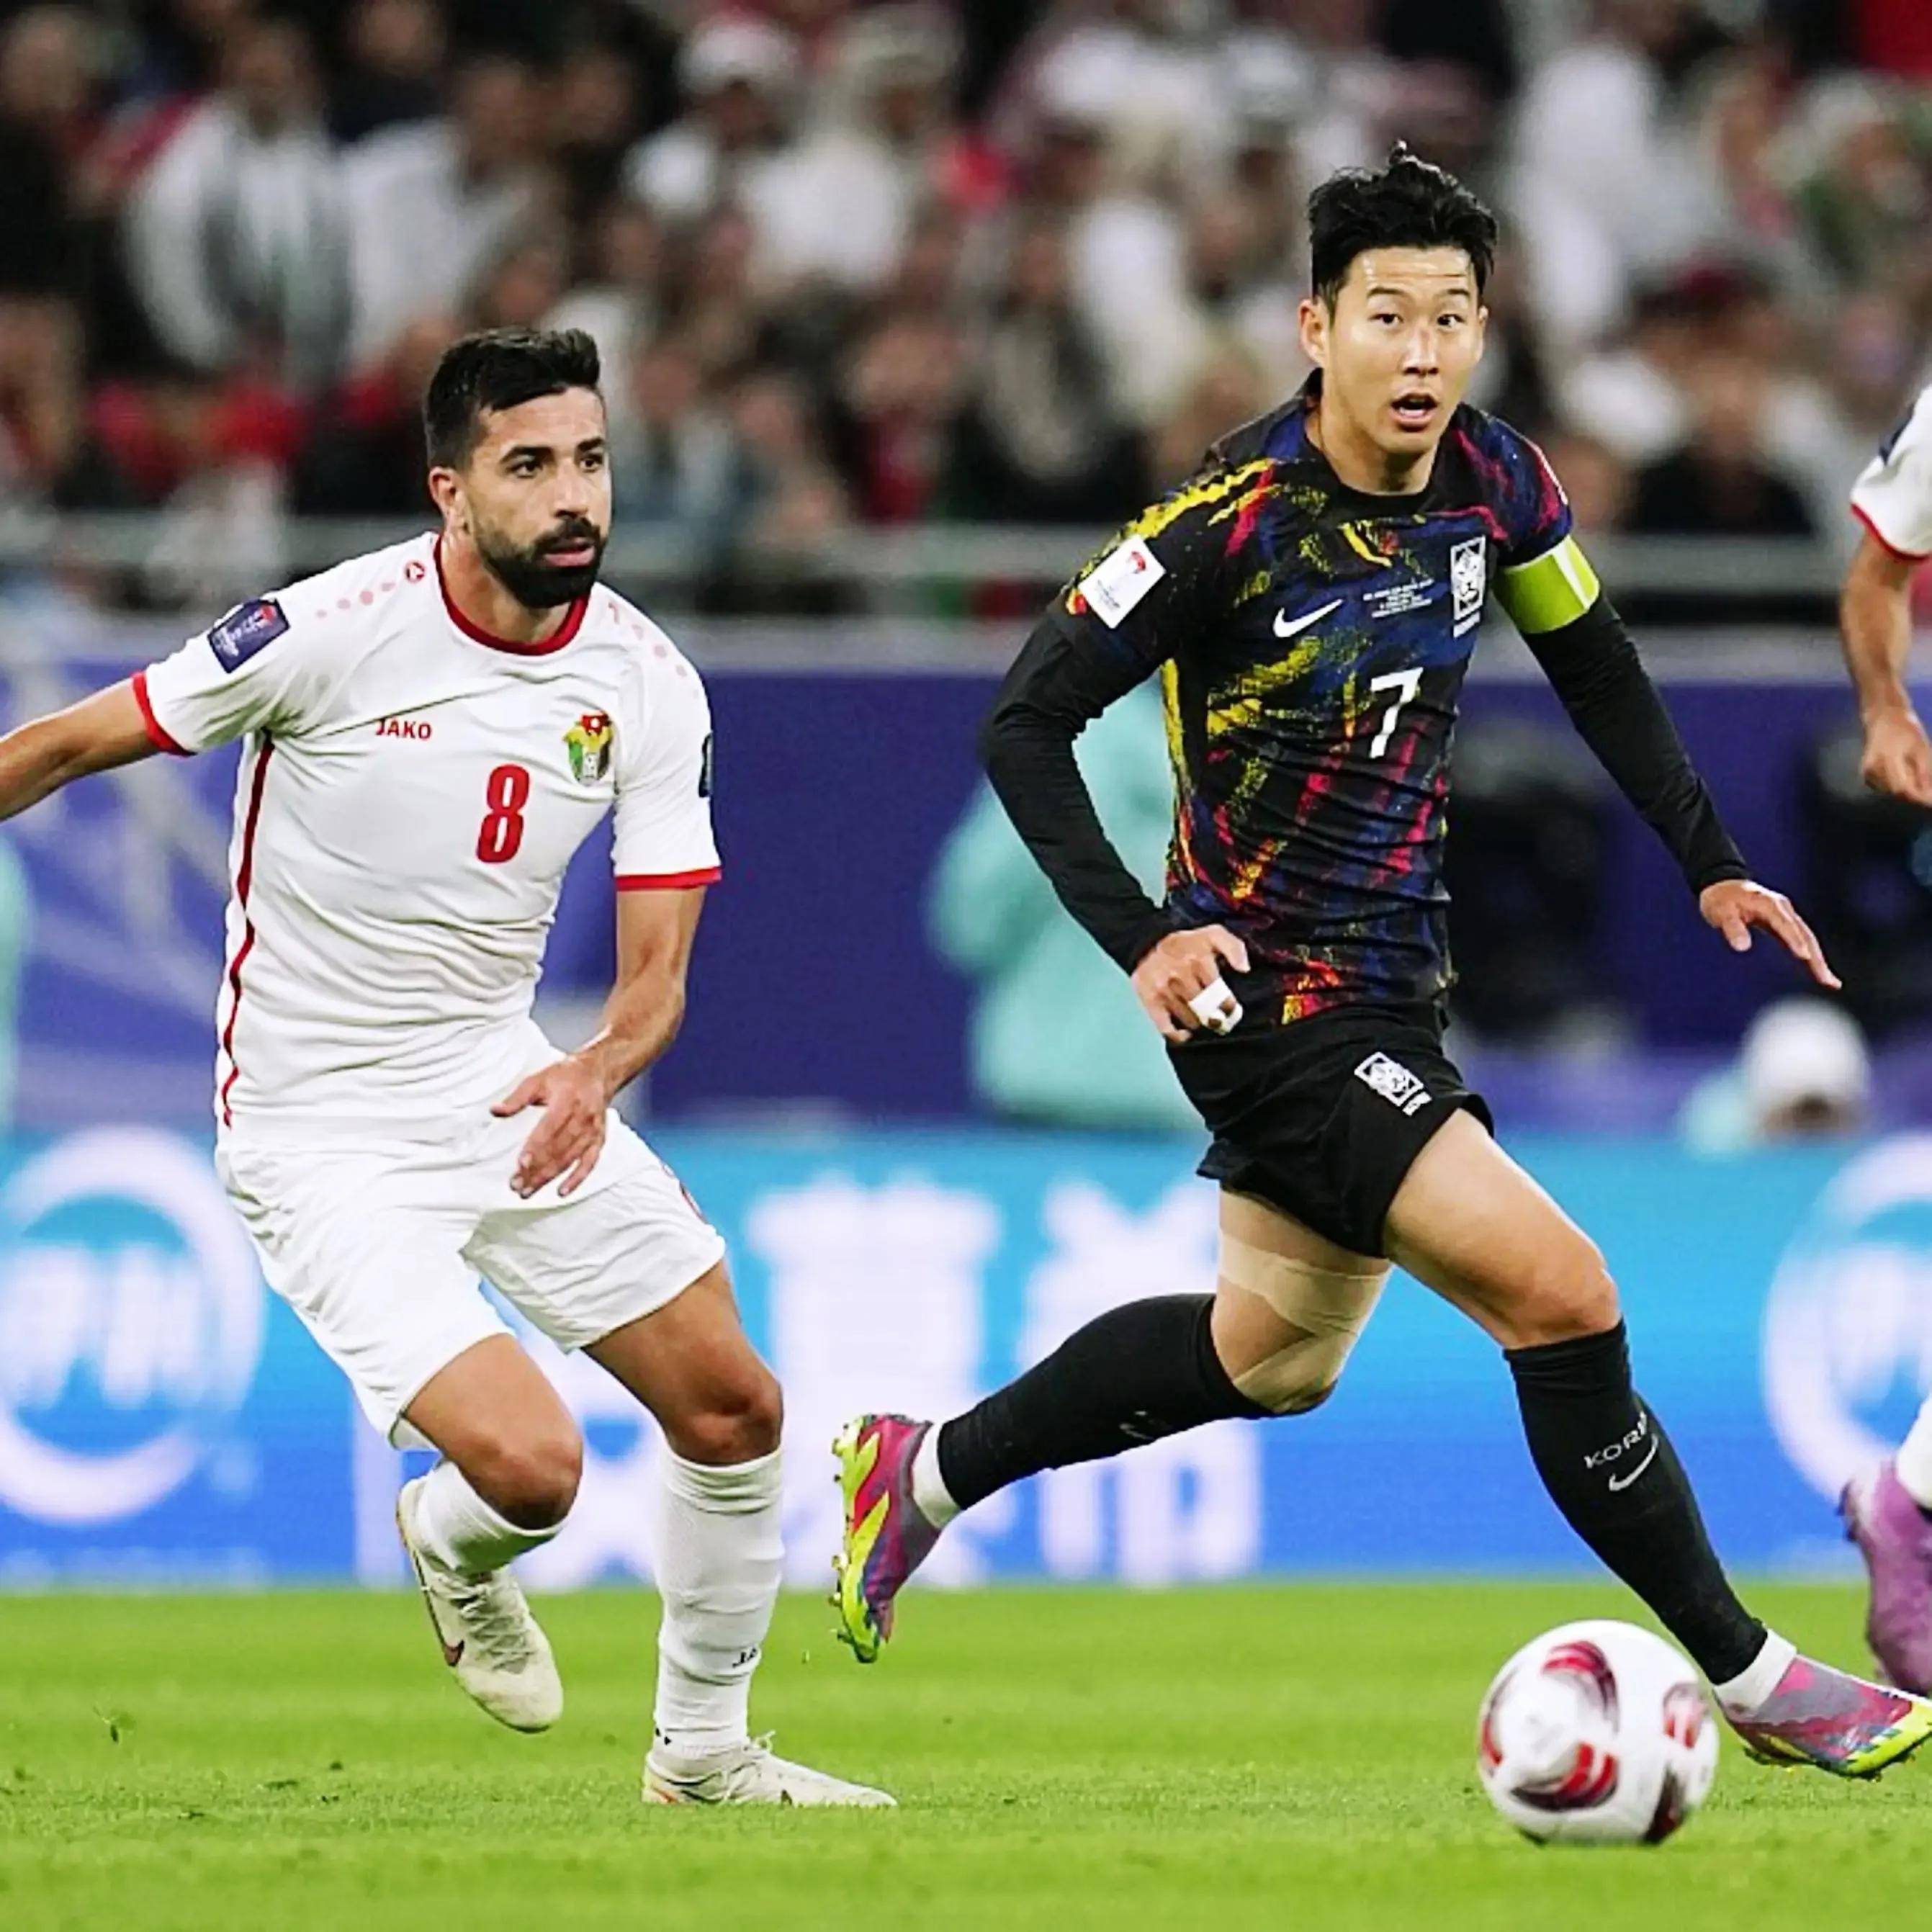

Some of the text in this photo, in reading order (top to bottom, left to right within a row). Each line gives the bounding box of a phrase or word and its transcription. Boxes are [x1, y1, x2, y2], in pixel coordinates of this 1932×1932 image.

[375, 719, 432, 740] JAKO
[1370, 667, 1424, 758] 7
[477, 765, 530, 863] 8
